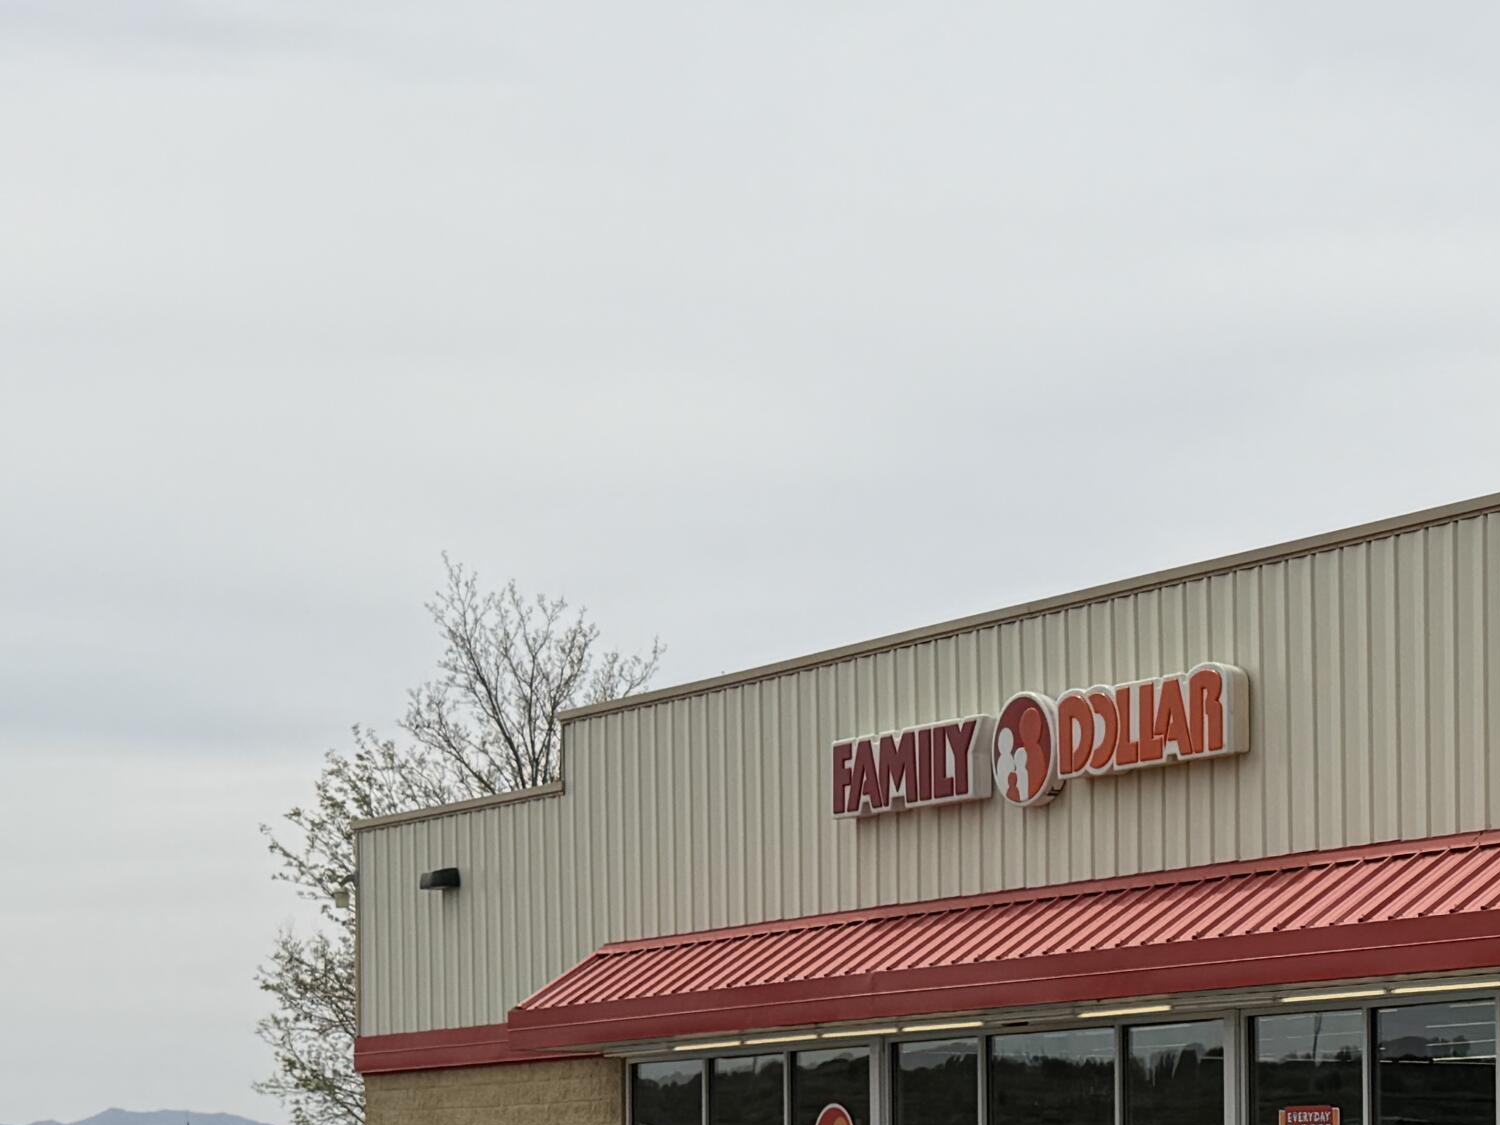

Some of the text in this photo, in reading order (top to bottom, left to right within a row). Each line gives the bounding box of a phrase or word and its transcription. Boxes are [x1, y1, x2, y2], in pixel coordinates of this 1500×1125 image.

[832, 667, 1224, 816] FAMILY DOLLAR
[1287, 1111, 1331, 1123] EVERYDAY
